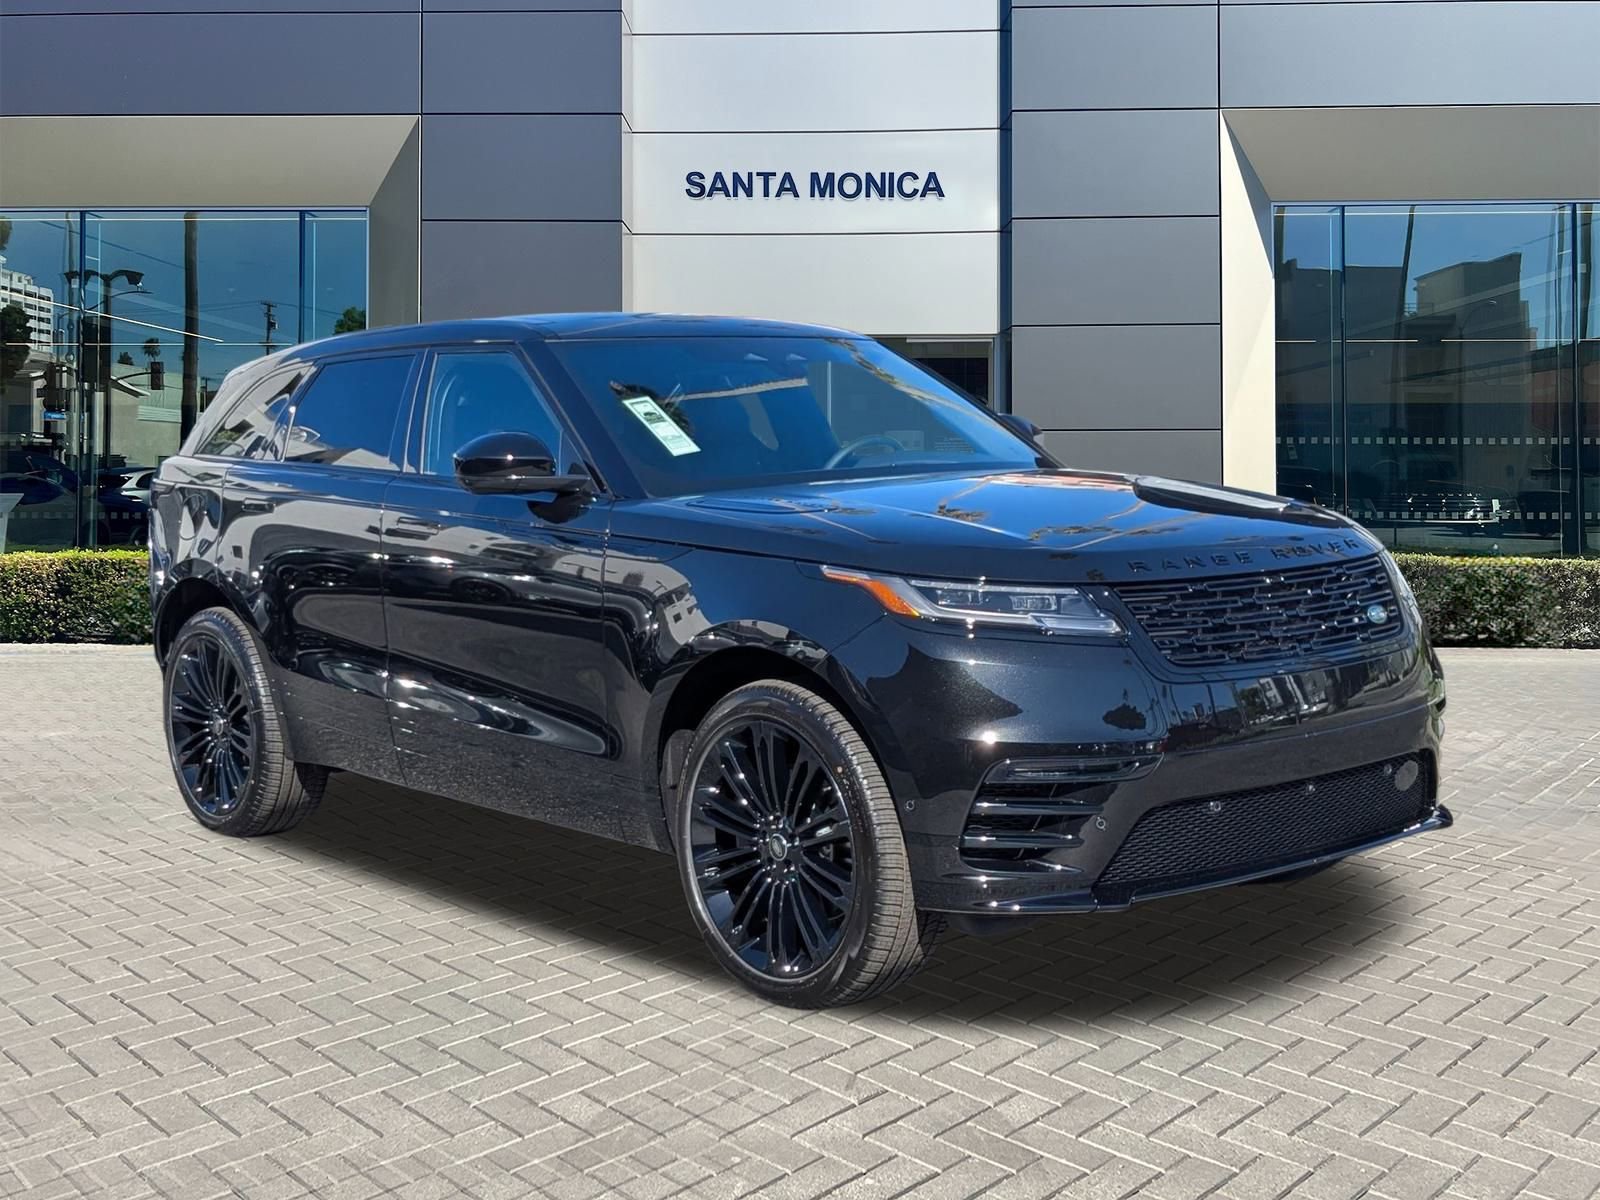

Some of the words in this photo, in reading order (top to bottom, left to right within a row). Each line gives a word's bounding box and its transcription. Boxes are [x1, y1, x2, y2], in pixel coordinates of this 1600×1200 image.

[685, 171, 800, 199] SANTA
[809, 171, 946, 199] MONICA
[1127, 550, 1254, 573] RANGE
[1270, 537, 1360, 560] ROVER
